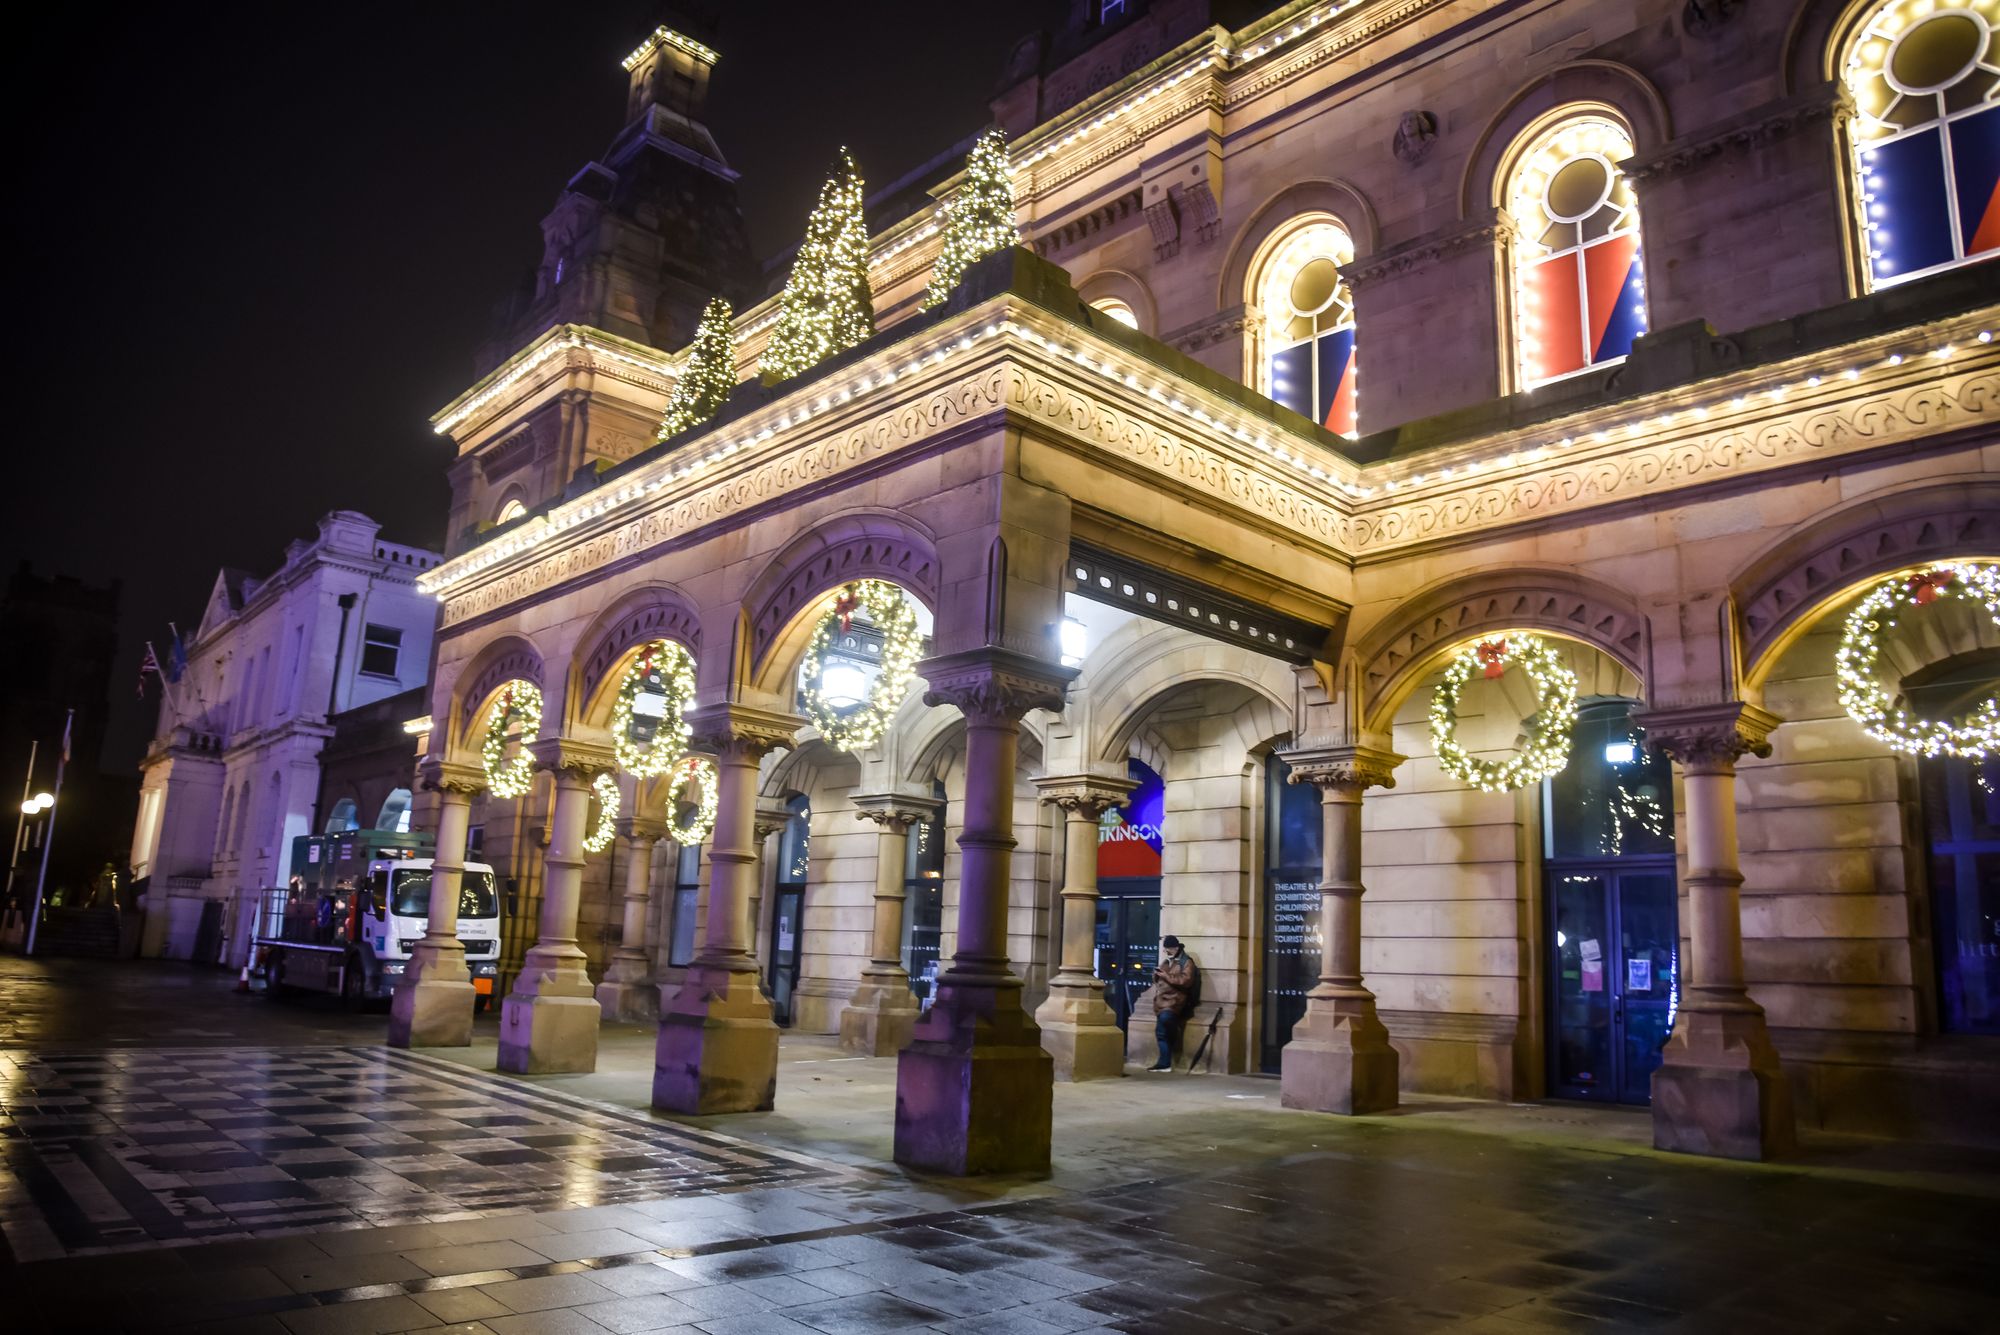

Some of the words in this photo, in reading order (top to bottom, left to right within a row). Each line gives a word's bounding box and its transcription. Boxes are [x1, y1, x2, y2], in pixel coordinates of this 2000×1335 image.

[1098, 823, 1165, 842] TKINSON
[1275, 883, 1307, 891] THEATRE
[1275, 893, 1320, 901] EXHIBITIONS
[1275, 903, 1319, 911] CHILDREN'S
[1275, 935, 1303, 943] TOURIST
